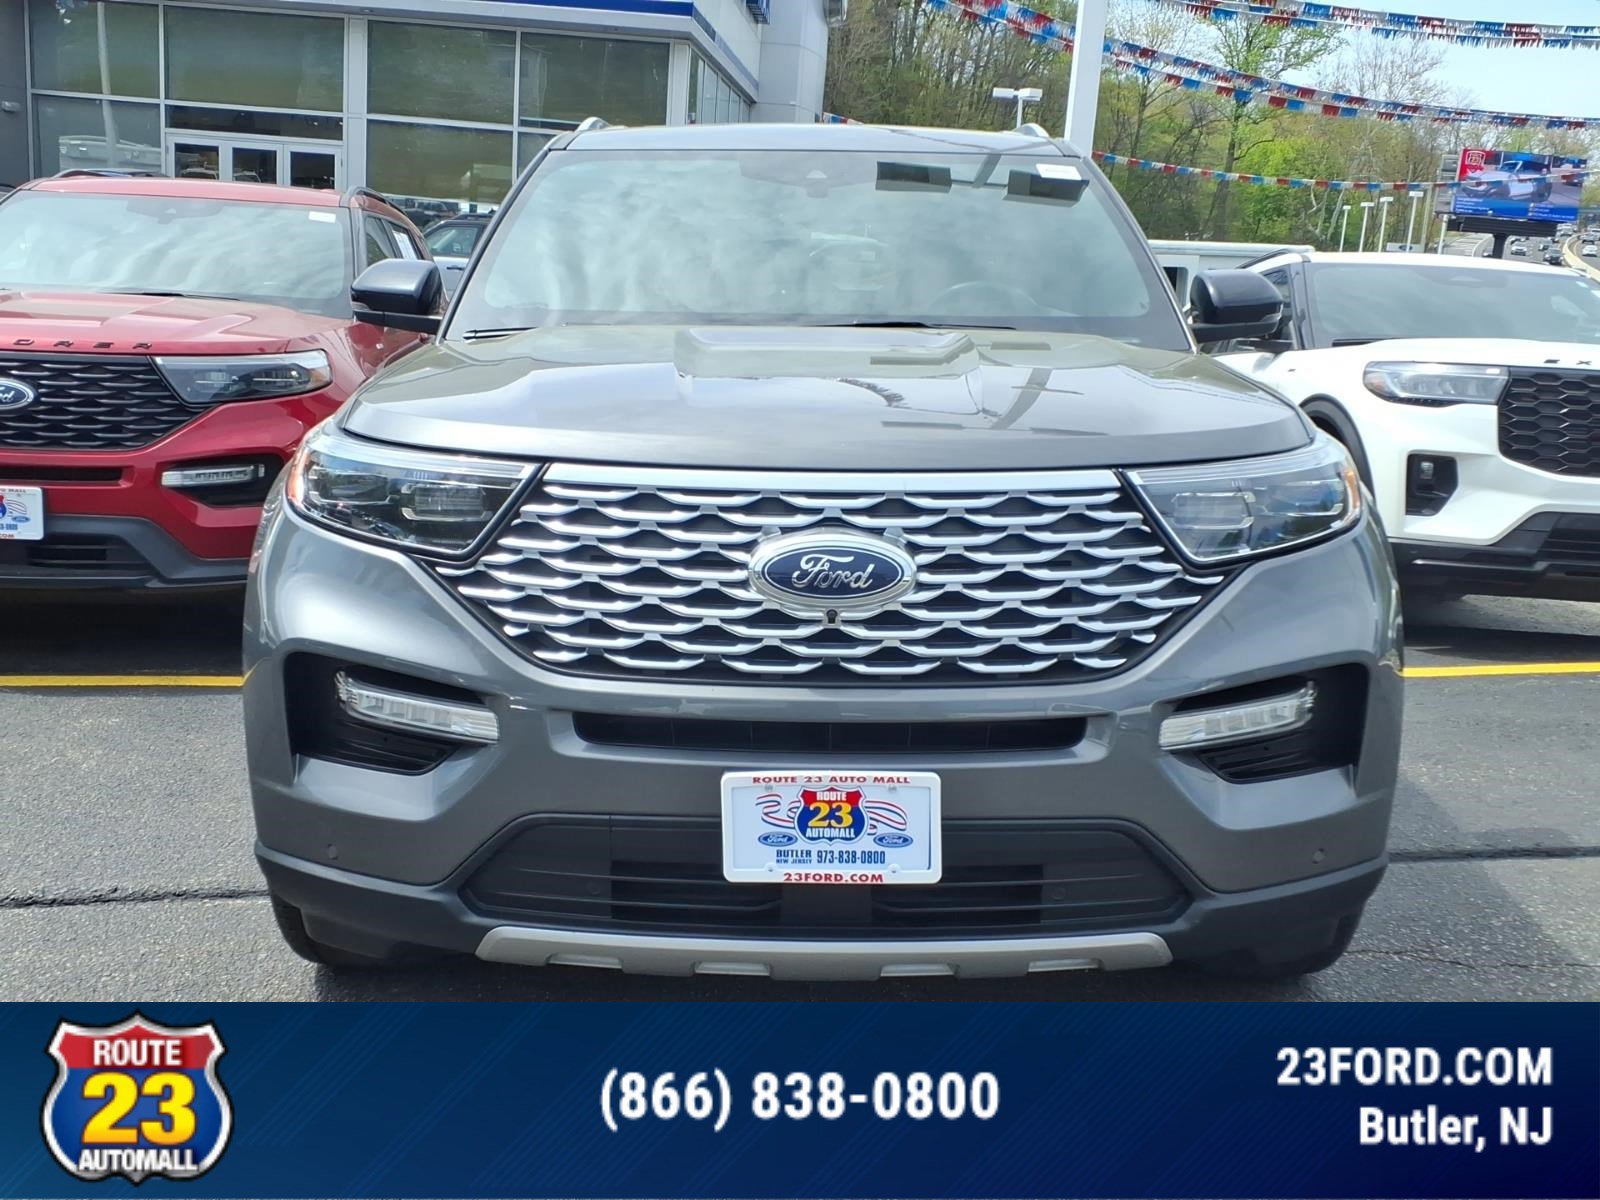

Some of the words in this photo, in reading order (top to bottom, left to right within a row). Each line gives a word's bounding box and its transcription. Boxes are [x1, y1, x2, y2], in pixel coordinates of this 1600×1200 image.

[791, 553, 875, 589] Ford
[752, 776, 797, 784] ROUTE
[828, 776, 868, 784] AUTO
[872, 776, 911, 784] MALL
[816, 791, 848, 801] ROUTE
[807, 802, 854, 828] 23
[805, 828, 856, 838] AUTOMALL
[775, 849, 812, 858] BUTLER
[816, 850, 886, 864] 973-838-0800
[783, 872, 884, 882] 23FORD.COM
